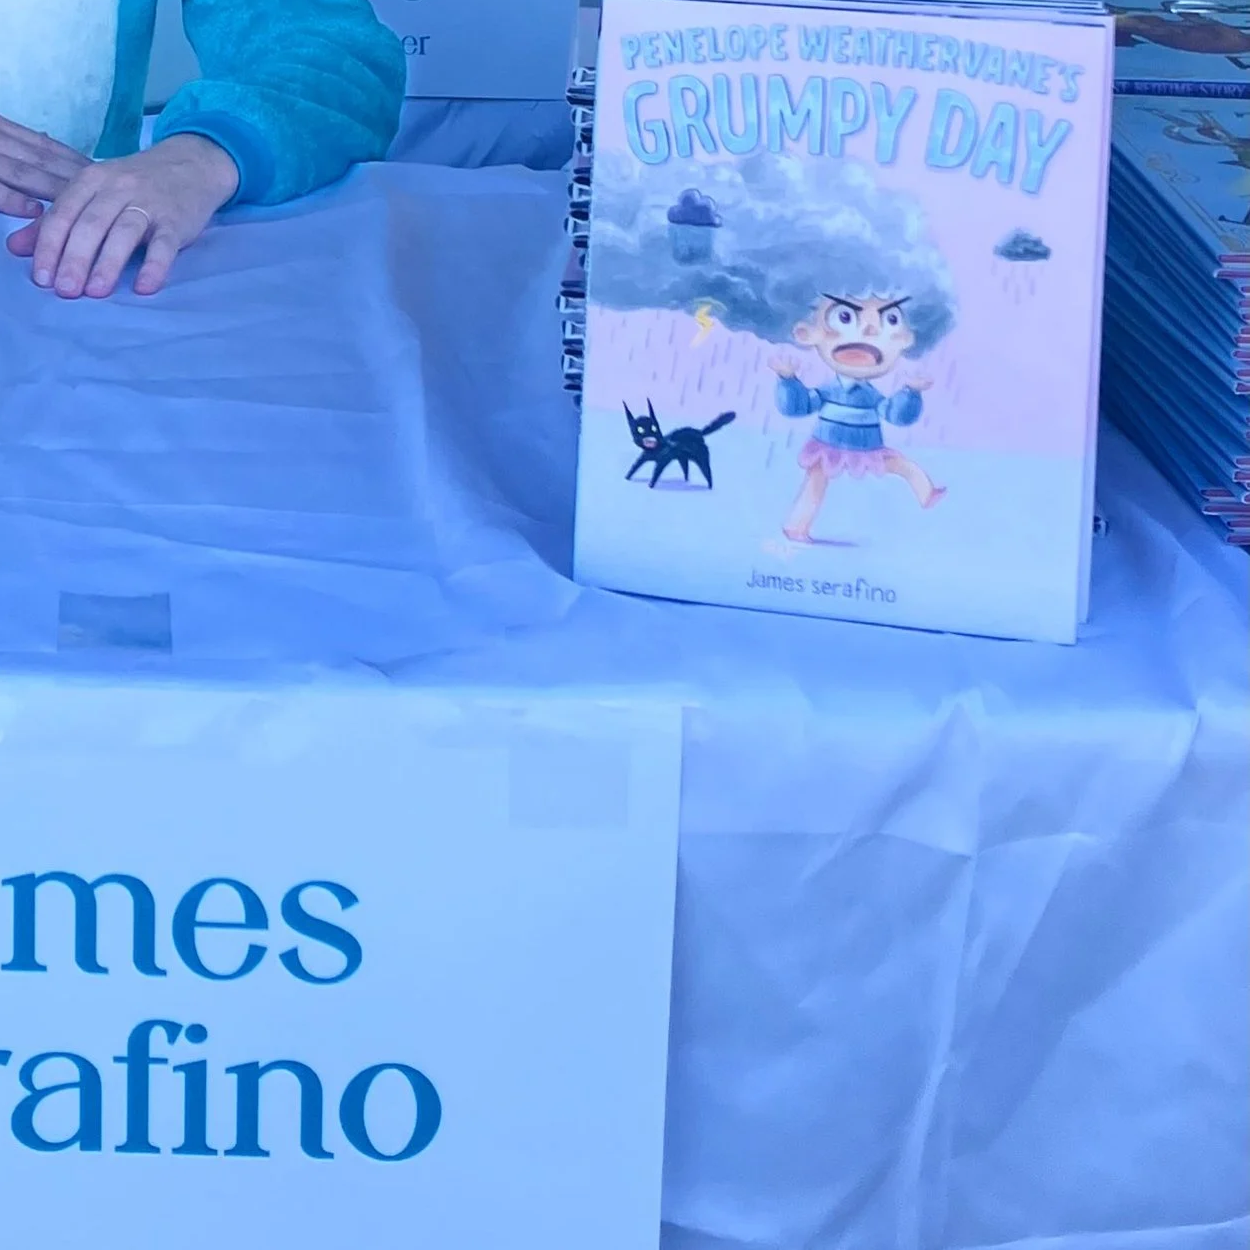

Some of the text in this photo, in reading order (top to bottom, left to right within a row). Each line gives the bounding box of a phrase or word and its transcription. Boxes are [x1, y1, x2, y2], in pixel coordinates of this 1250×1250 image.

[620, 23, 1086, 104] PENELOPE WEATHERVANE'S
[622, 72, 1072, 195] GRUMPY DAY
[746, 568, 806, 593] James
